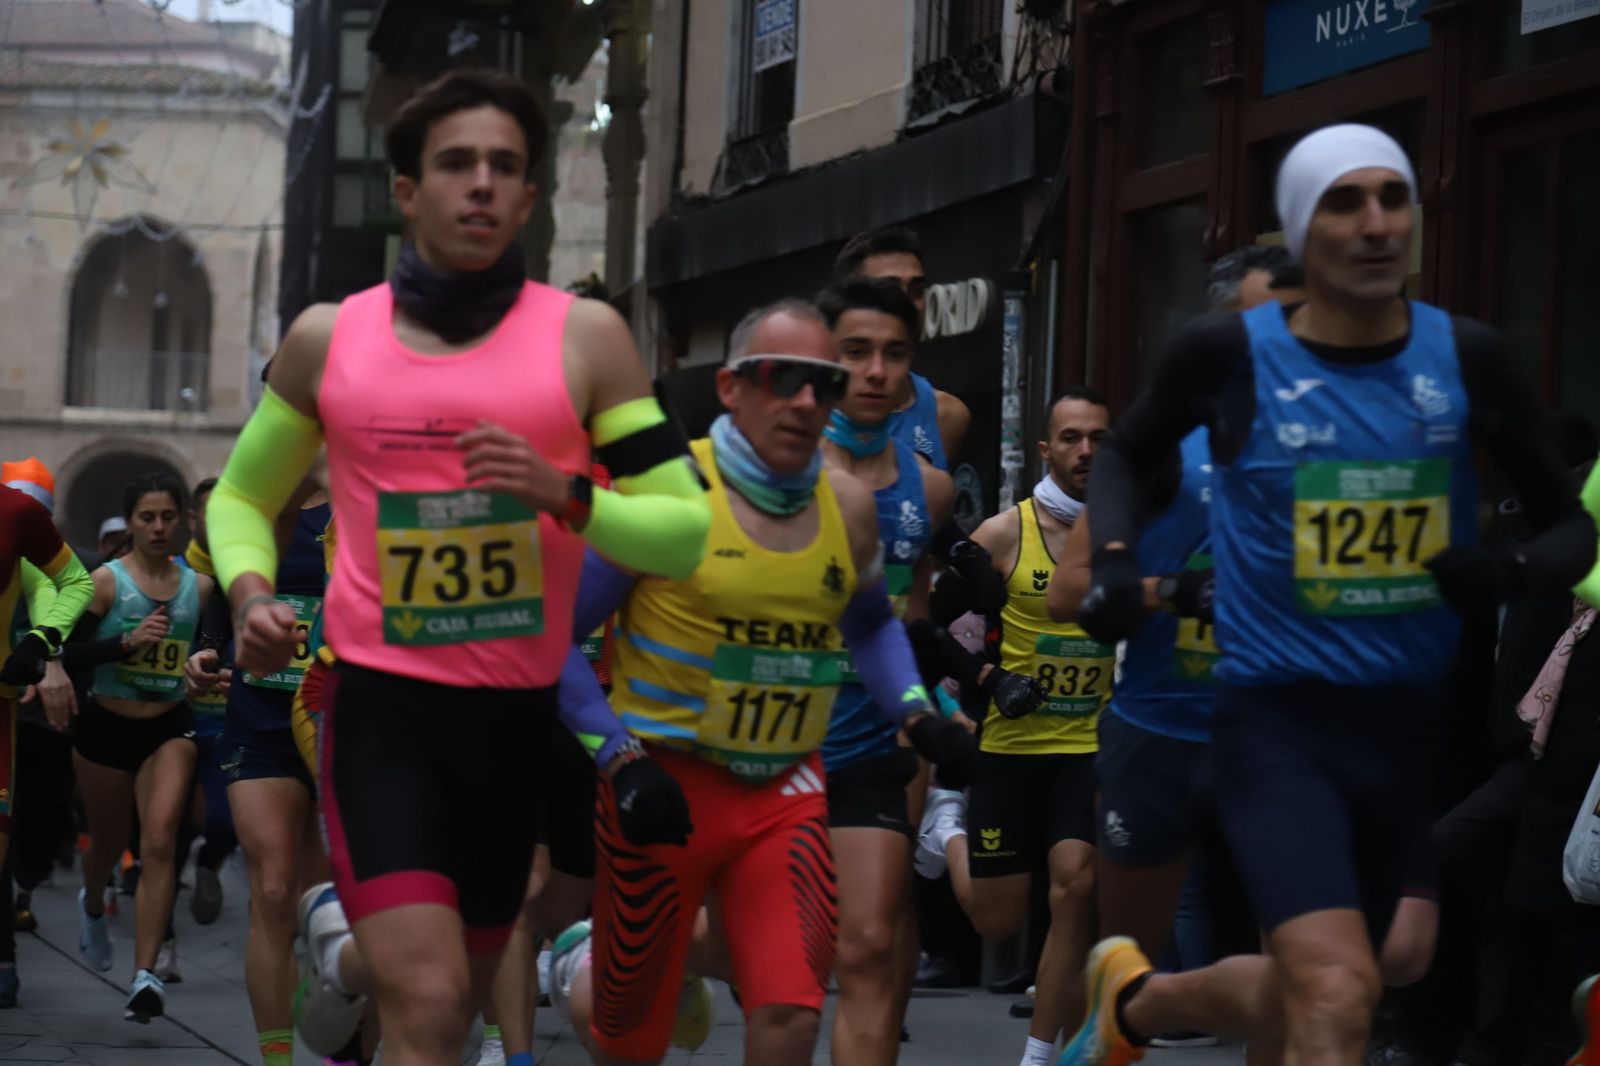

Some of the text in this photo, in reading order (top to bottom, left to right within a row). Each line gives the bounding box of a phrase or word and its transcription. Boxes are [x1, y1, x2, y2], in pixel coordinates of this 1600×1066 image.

[1316, 0, 1388, 43] NUXE
[1307, 505, 1430, 566] 1247
[387, 540, 517, 603] 735
[714, 616, 829, 650] TEAM
[1038, 662, 1102, 696] 832
[727, 688, 812, 743] 1171
